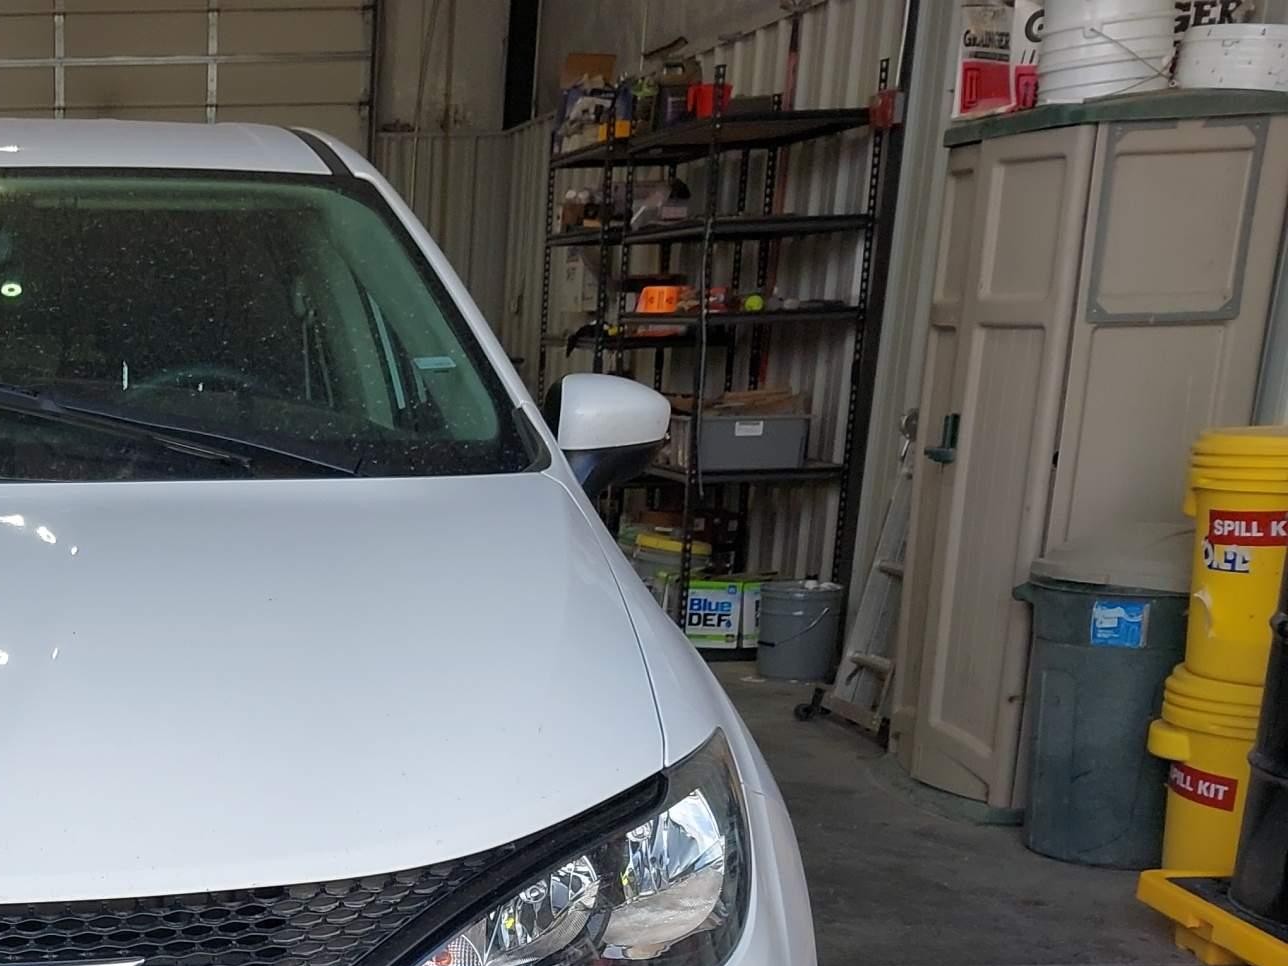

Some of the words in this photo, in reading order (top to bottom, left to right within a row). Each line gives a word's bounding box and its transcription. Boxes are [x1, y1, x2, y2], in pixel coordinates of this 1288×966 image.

[1213, 519, 1264, 537] SPILL
[689, 598, 732, 612] Blue
[688, 613, 731, 627] DEF
[1170, 765, 1194, 791] PILL
[1197, 780, 1229, 800] KIT
